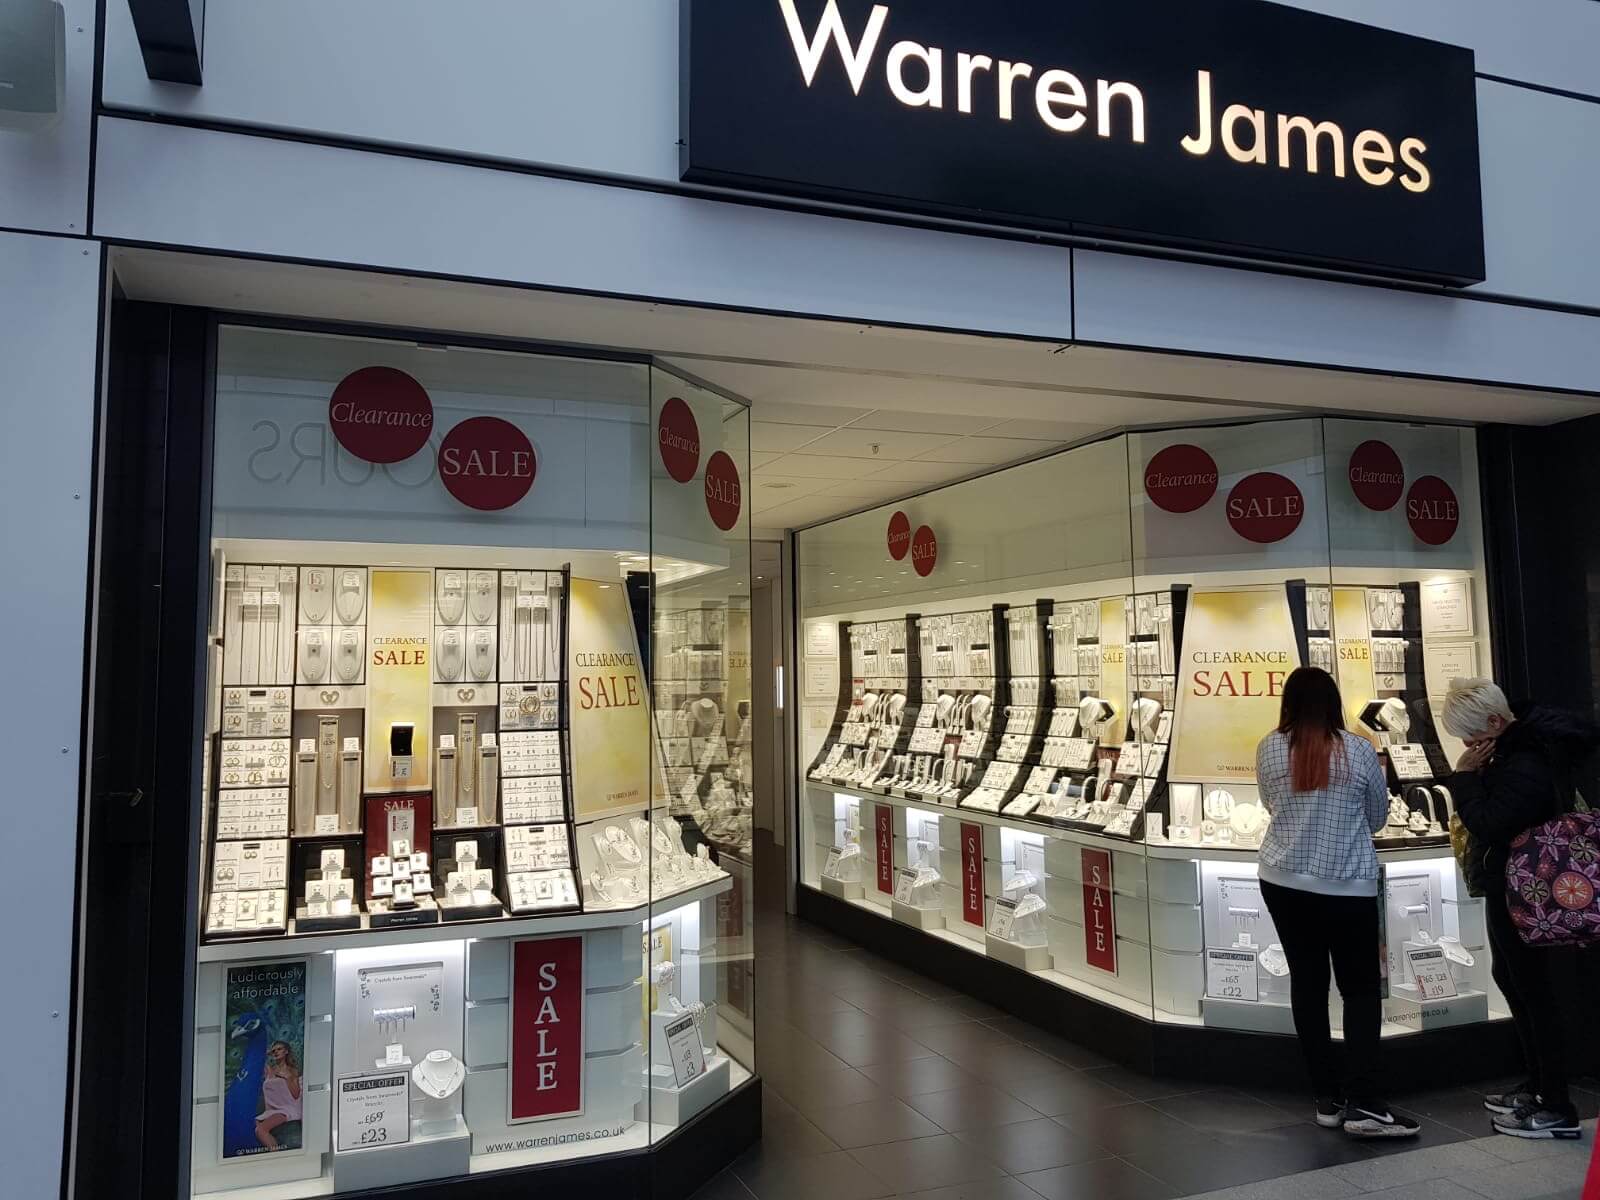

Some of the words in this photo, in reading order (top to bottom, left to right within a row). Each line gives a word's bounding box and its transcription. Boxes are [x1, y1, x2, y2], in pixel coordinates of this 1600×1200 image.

[778, 0, 1145, 143] Warren
[1180, 69, 1432, 193] James
[331, 402, 432, 427] Clearance
[660, 426, 699, 455] Clearance
[441, 448, 532, 479] SALE
[1145, 468, 1218, 488] Clearance
[1350, 466, 1403, 484] Clearance
[706, 475, 739, 506] SALE
[1229, 496, 1300, 519] SALE
[1408, 499, 1457, 520] SALE
[912, 541, 936, 560] SALE
[373, 637, 427, 645] CLEARANCE
[373, 650, 425, 666] SALE
[575, 652, 635, 668] CLEARANCE
[1102, 653, 1123, 663] SALE
[1192, 650, 1287, 664] CLEARANCE
[1340, 648, 1368, 660] SALE
[579, 675, 640, 710] SALE
[1192, 670, 1286, 697] SALE
[384, 800, 414, 811] SALE
[877, 816, 889, 881] SALE
[967, 837, 978, 910] SALE
[1091, 865, 1106, 952] SALE
[230, 967, 304, 984] Ludicrously
[233, 982, 299, 999] affordable
[534, 962, 561, 1091] SALE
[344, 1081, 375, 1091] SPECIAL
[379, 1077, 403, 1087] OFFER
[364, 1111, 384, 1124] £69
[361, 1127, 387, 1144] £23
[485, 1126, 625, 1153] www.warrenjames.co.uk
